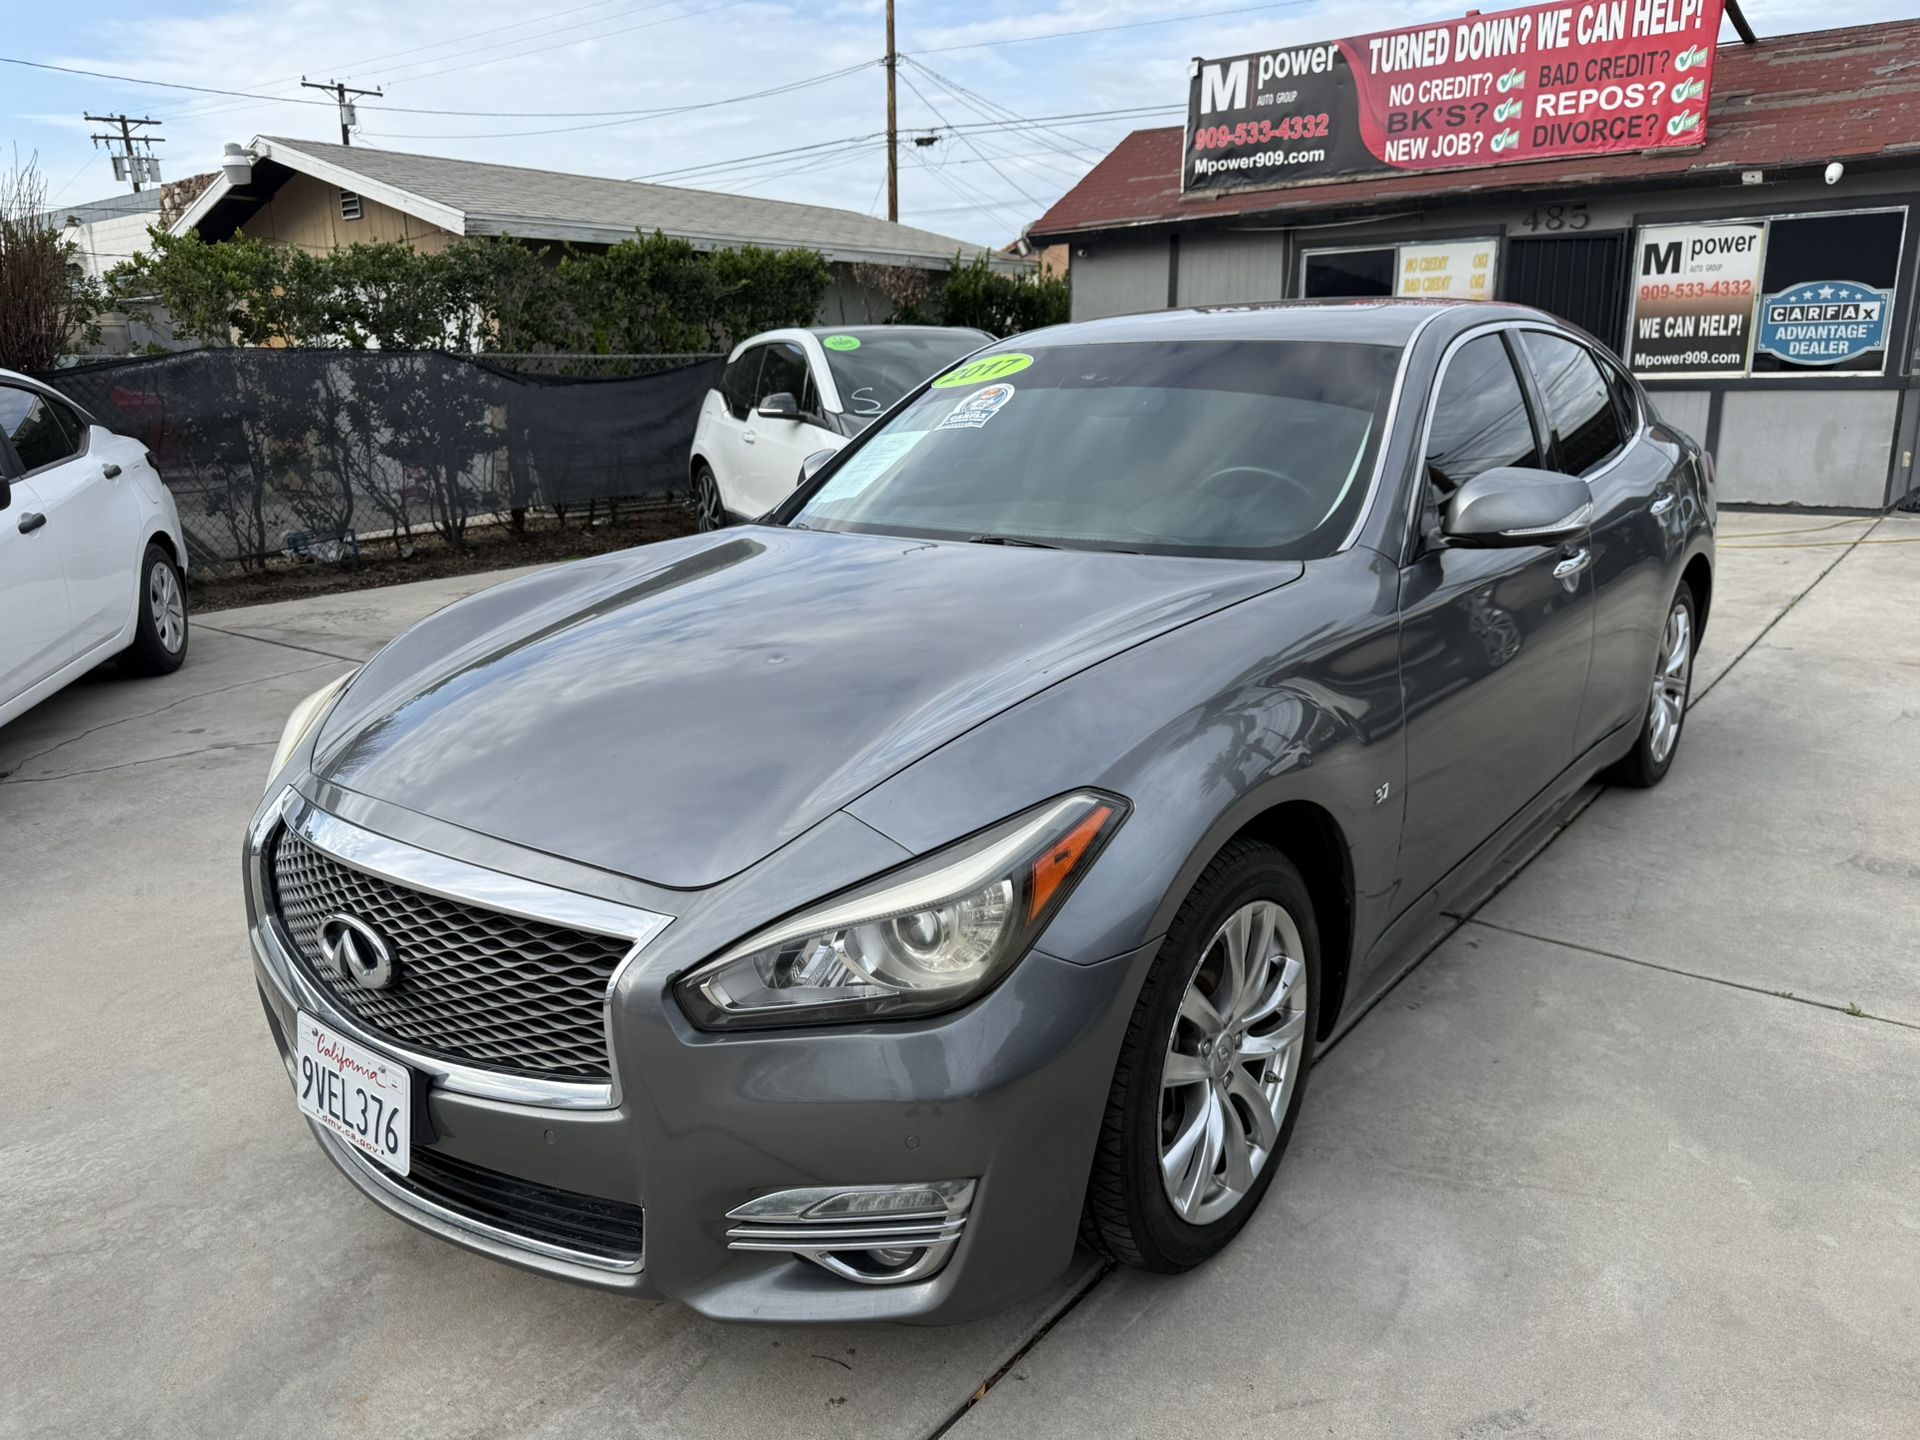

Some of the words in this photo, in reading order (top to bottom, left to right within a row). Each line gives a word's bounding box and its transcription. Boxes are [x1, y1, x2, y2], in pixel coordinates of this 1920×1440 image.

[1369, 28, 1450, 74] TURNED
[1454, 17, 1532, 63] DOWN?
[1537, 8, 1573, 50] WE
[1577, 1, 1627, 45] CAN
[1631, 0, 1704, 38] HELP!
[1257, 45, 1339, 90] power
[1538, 61, 1580, 88] BAD
[1584, 50, 1671, 83] CREDIT?
[1200, 59, 1250, 115] M
[1256, 94, 1275, 106] AUTO
[1276, 91, 1298, 104] GROUP
[1388, 83, 1415, 107] NO
[1418, 72, 1494, 103] CREDIT?
[1535, 81, 1667, 118] REPOS?
[1195, 113, 1330, 151] 909-533-4332
[1386, 102, 1489, 134] BK'S?
[1532, 113, 1660, 148] DIVORCE?
[1194, 149, 1326, 175] Mpower909.com
[1384, 137, 1430, 163] NEW
[1431, 131, 1485, 158] JOB?
[1522, 204, 1591, 232] 485
[1642, 241, 1683, 276] M
[1690, 234, 1757, 261] power
[1641, 280, 1751, 300] 909-533-4332
[1639, 317, 1662, 339] WE
[1664, 315, 1696, 338] CAN
[1698, 314, 1743, 336] HELP!
[1771, 304, 1877, 321] CARFAX
[1634, 351, 1741, 368] Mpower909.com
[1788, 341, 1850, 355] DEALER
[939, 357, 1026, 385] 2017
[316, 1033, 387, 1089] California
[302, 1055, 400, 1155] 9VEL376
[321, 1113, 379, 1154] dmv.ca.gov
